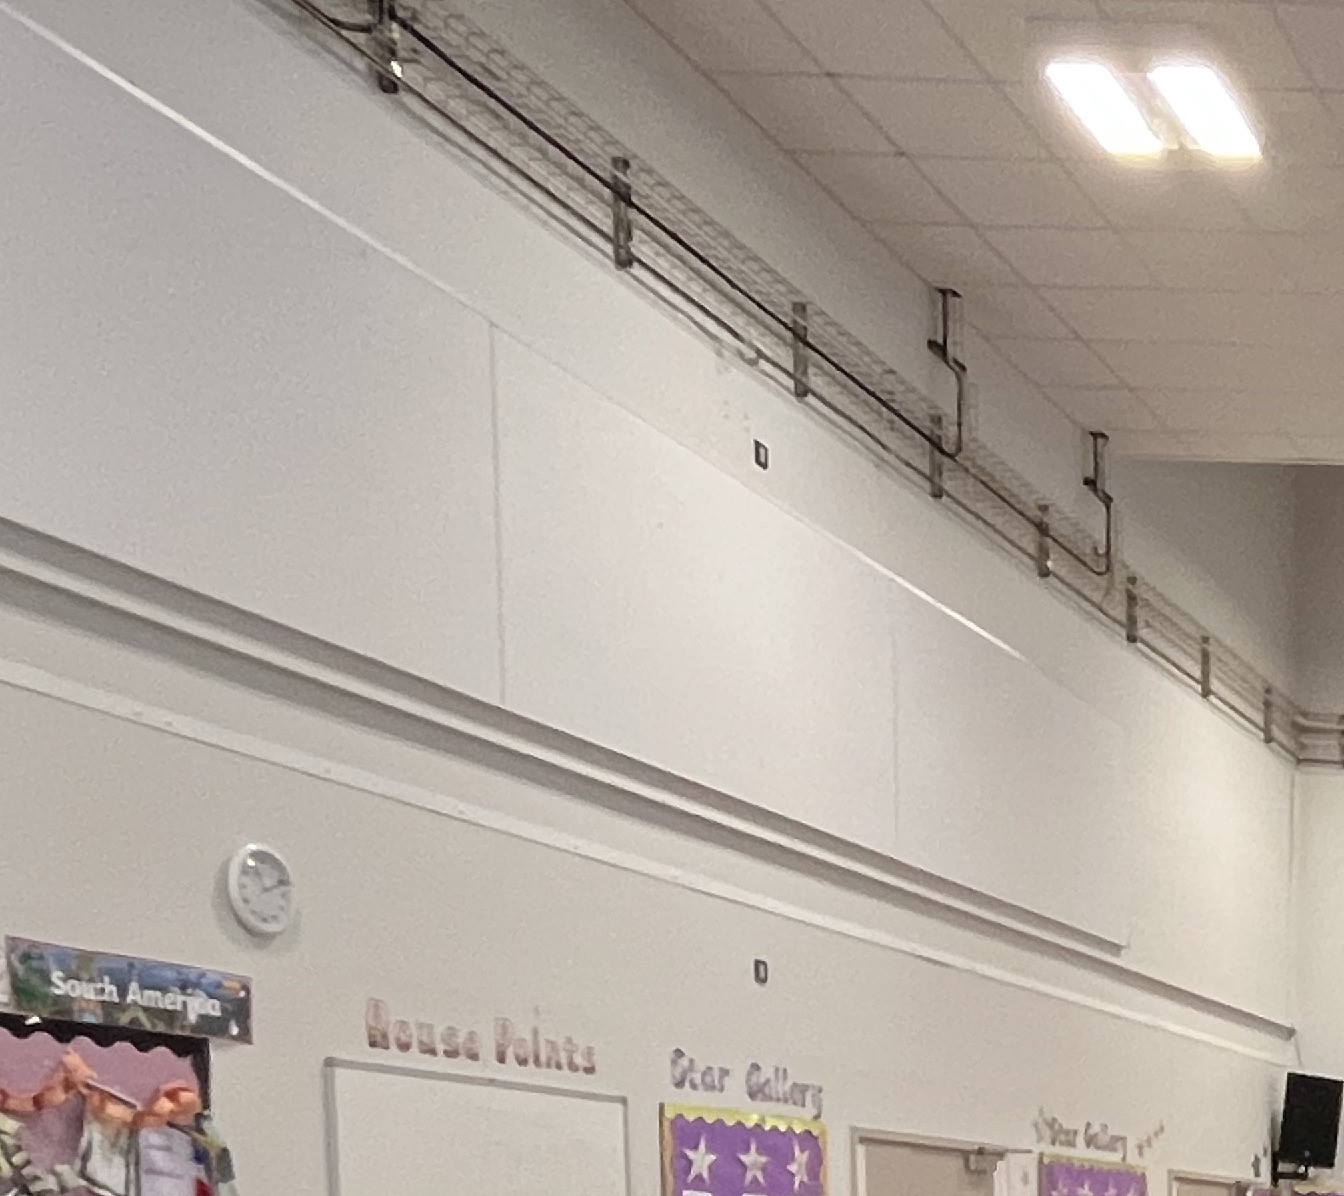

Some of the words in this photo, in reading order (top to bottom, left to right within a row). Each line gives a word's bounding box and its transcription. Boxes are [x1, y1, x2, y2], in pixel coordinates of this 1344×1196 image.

[51, 970, 119, 1003] South
[365, 997, 480, 1062] House
[494, 1005, 596, 1075] Points
[671, 1047, 730, 1093] Star
[745, 1062, 823, 1120] Gallery
